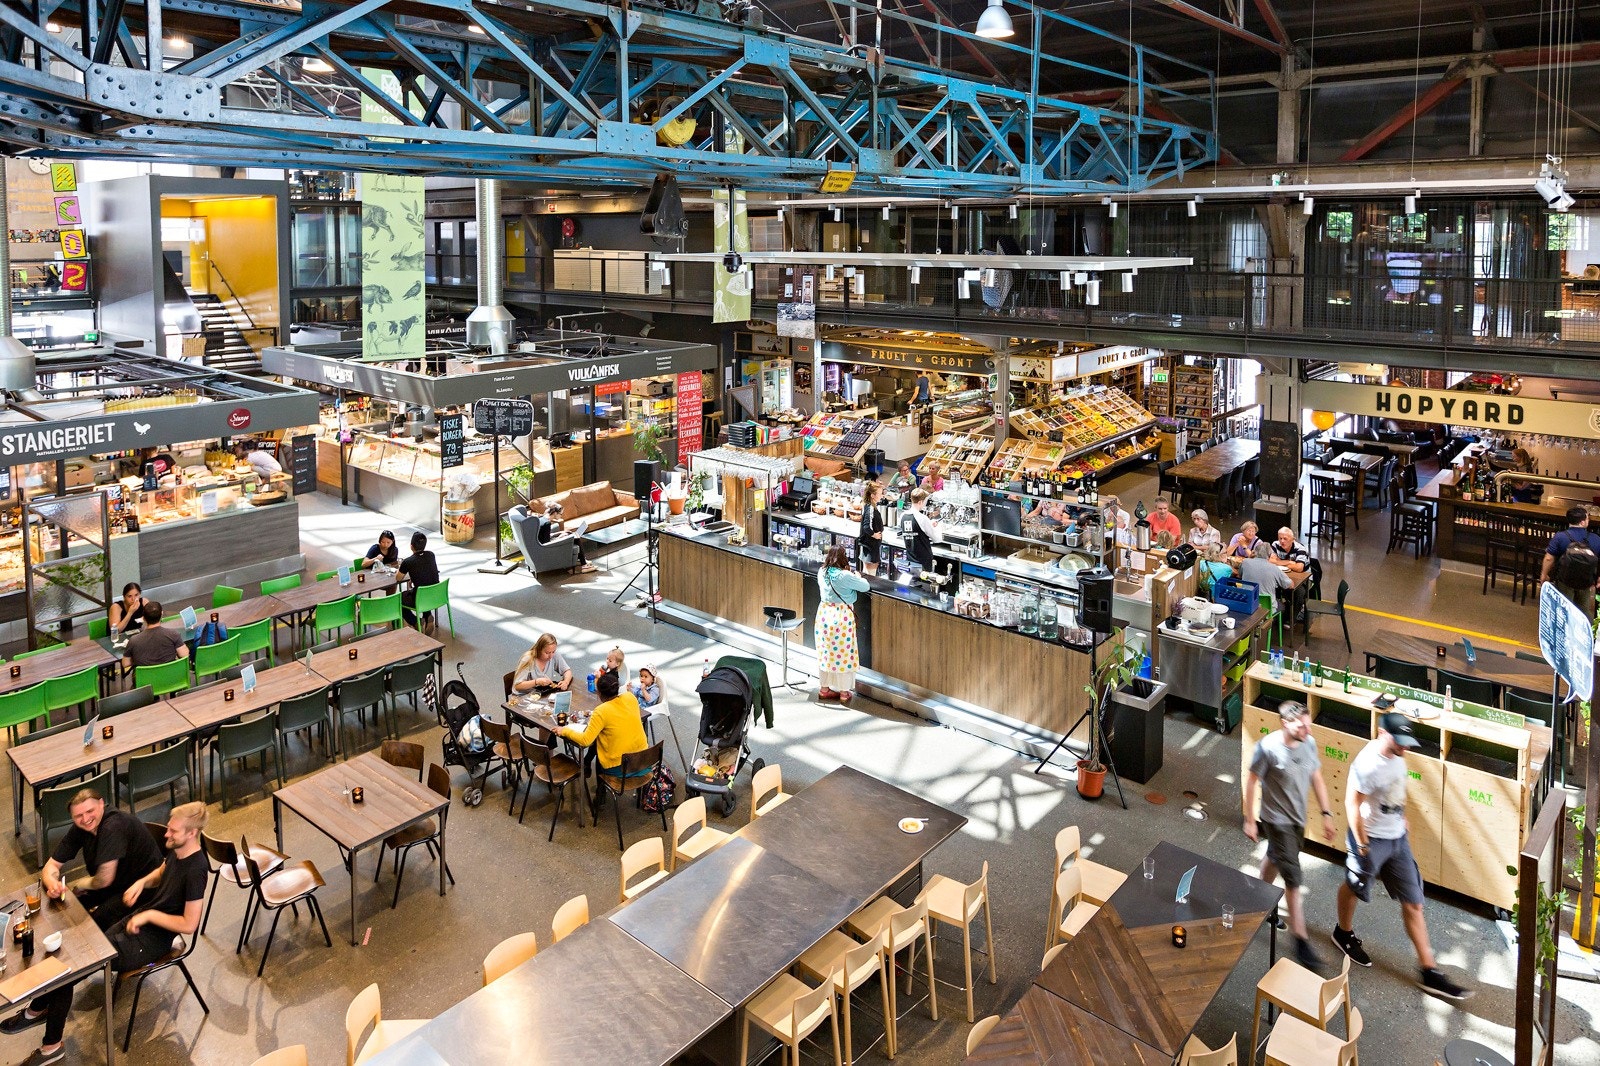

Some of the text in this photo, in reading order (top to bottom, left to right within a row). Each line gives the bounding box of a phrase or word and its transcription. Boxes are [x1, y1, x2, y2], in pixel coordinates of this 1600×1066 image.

[568, 364, 620, 381] VULKANFISK
[1376, 391, 1524, 425] HOPYARD
[2, 422, 116, 456] STANGERIET
[1367, 680, 1382, 689] FOR
[1385, 685, 1396, 693] AT
[1399, 688, 1411, 697] DU
[1325, 746, 1350, 760] REST
[1406, 769, 1422, 781] PIR
[1468, 788, 1494, 802] MAT
